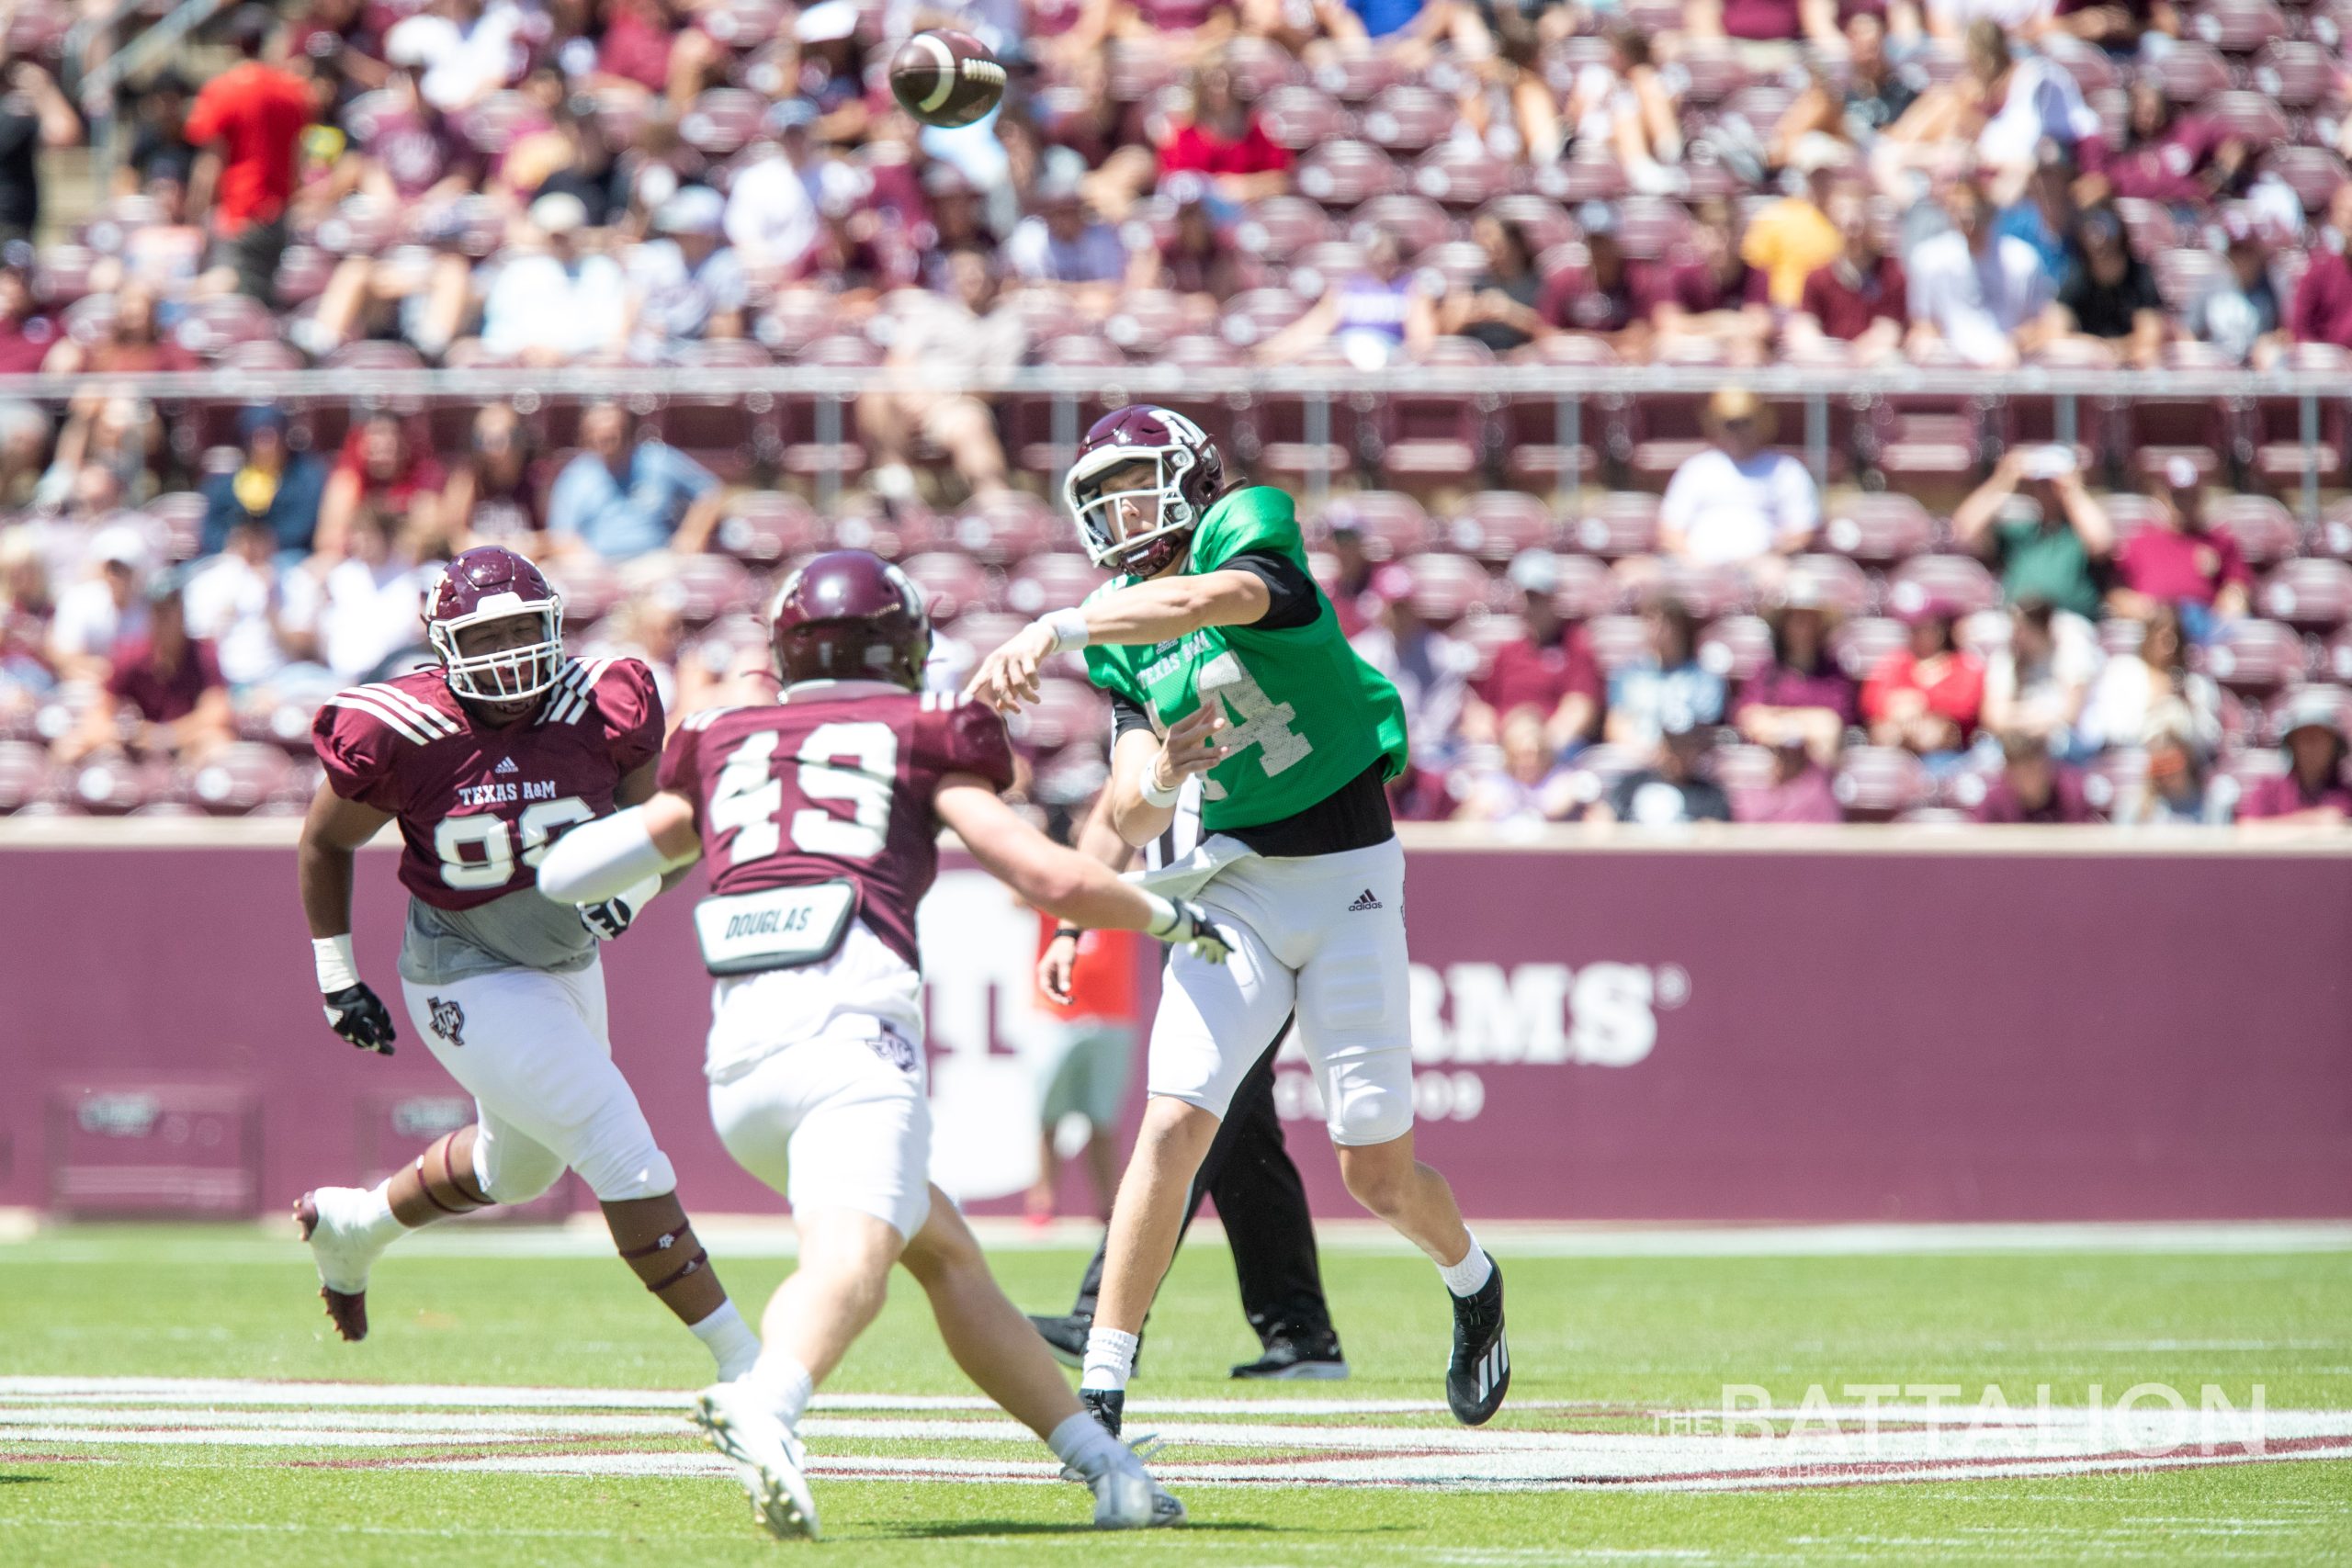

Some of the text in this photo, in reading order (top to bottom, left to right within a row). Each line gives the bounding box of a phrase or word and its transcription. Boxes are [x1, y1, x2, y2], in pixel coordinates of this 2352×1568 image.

[1136, 651, 1181, 691] TEXAS
[458, 780, 557, 807] TEXAS A&M
[708, 721, 899, 864] 49
[1348, 901, 1384, 912] adidas
[725, 907, 813, 941] DOUGLAS
